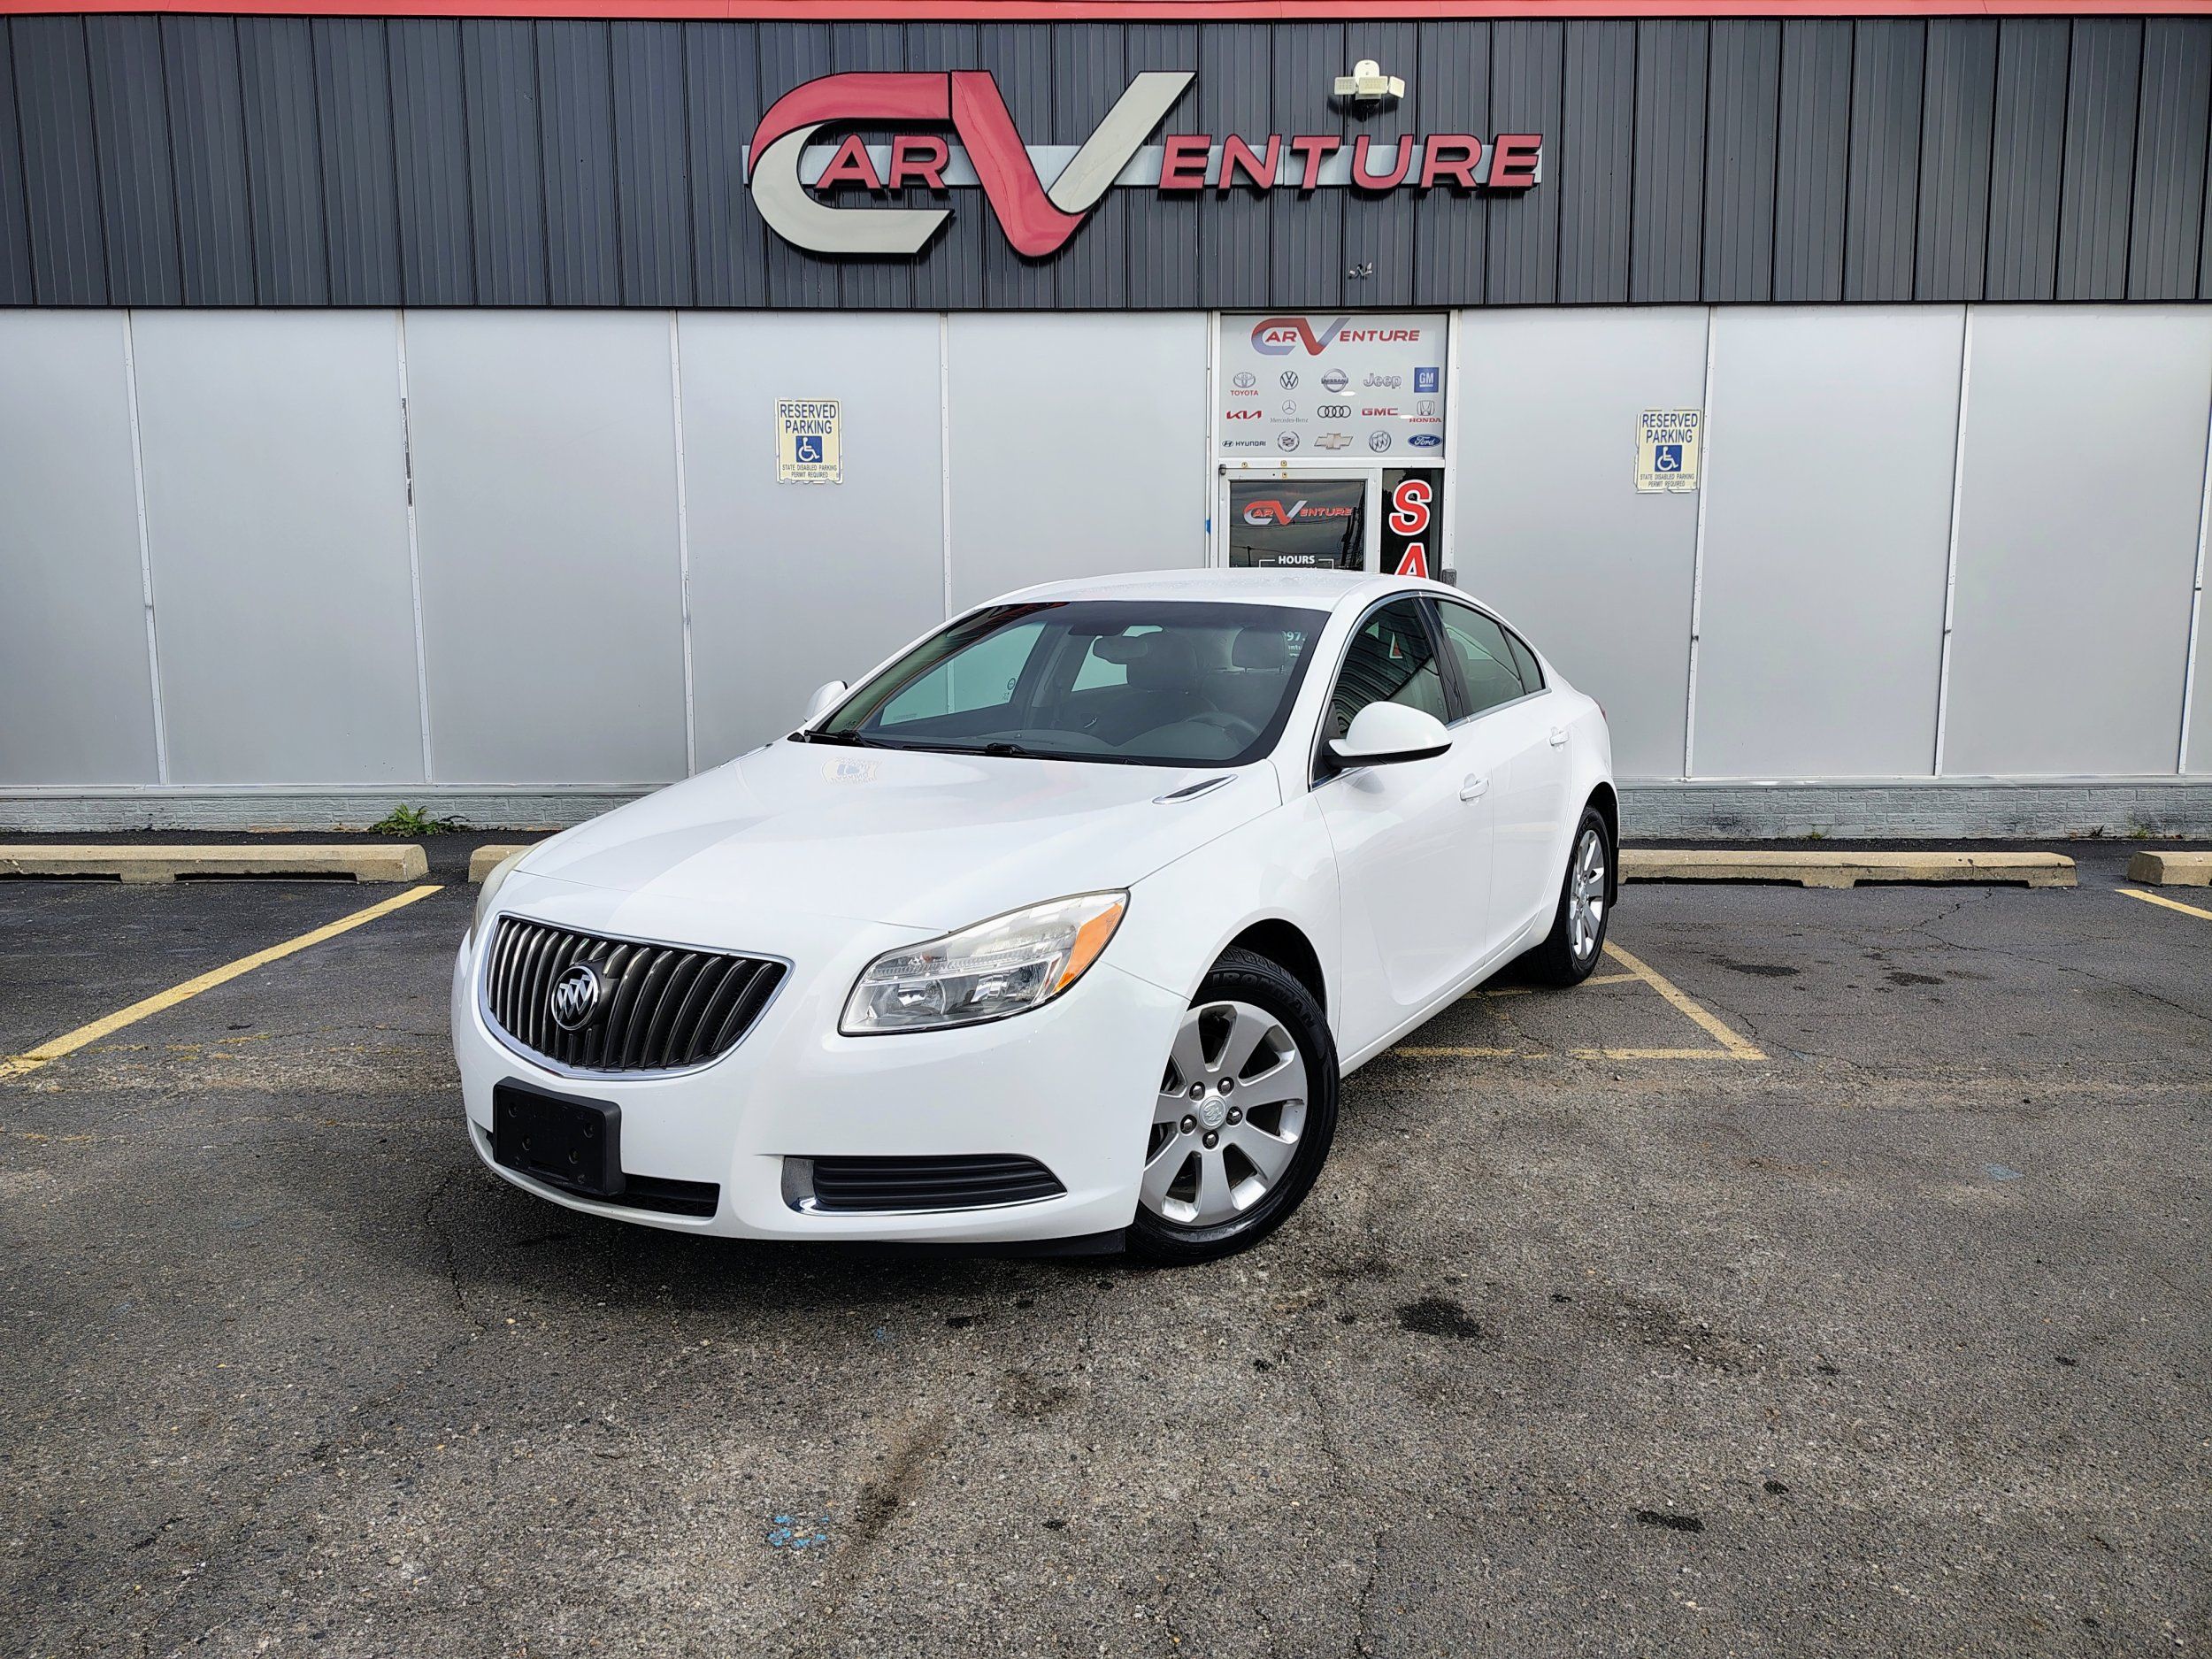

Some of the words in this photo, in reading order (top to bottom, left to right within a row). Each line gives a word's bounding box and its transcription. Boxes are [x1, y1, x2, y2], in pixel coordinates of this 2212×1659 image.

[1363, 373, 1402, 389] Jeep
[1418, 372, 1434, 385] GM
[780, 403, 837, 419] RESERVED
[1361, 407, 1399, 416] GMC
[785, 419, 833, 434] PARKING
[1641, 413, 1698, 428] RESERVED
[1414, 435, 1435, 448] Ford
[1646, 428, 1693, 443] PARKING
[1278, 555, 1316, 565] HOURS
